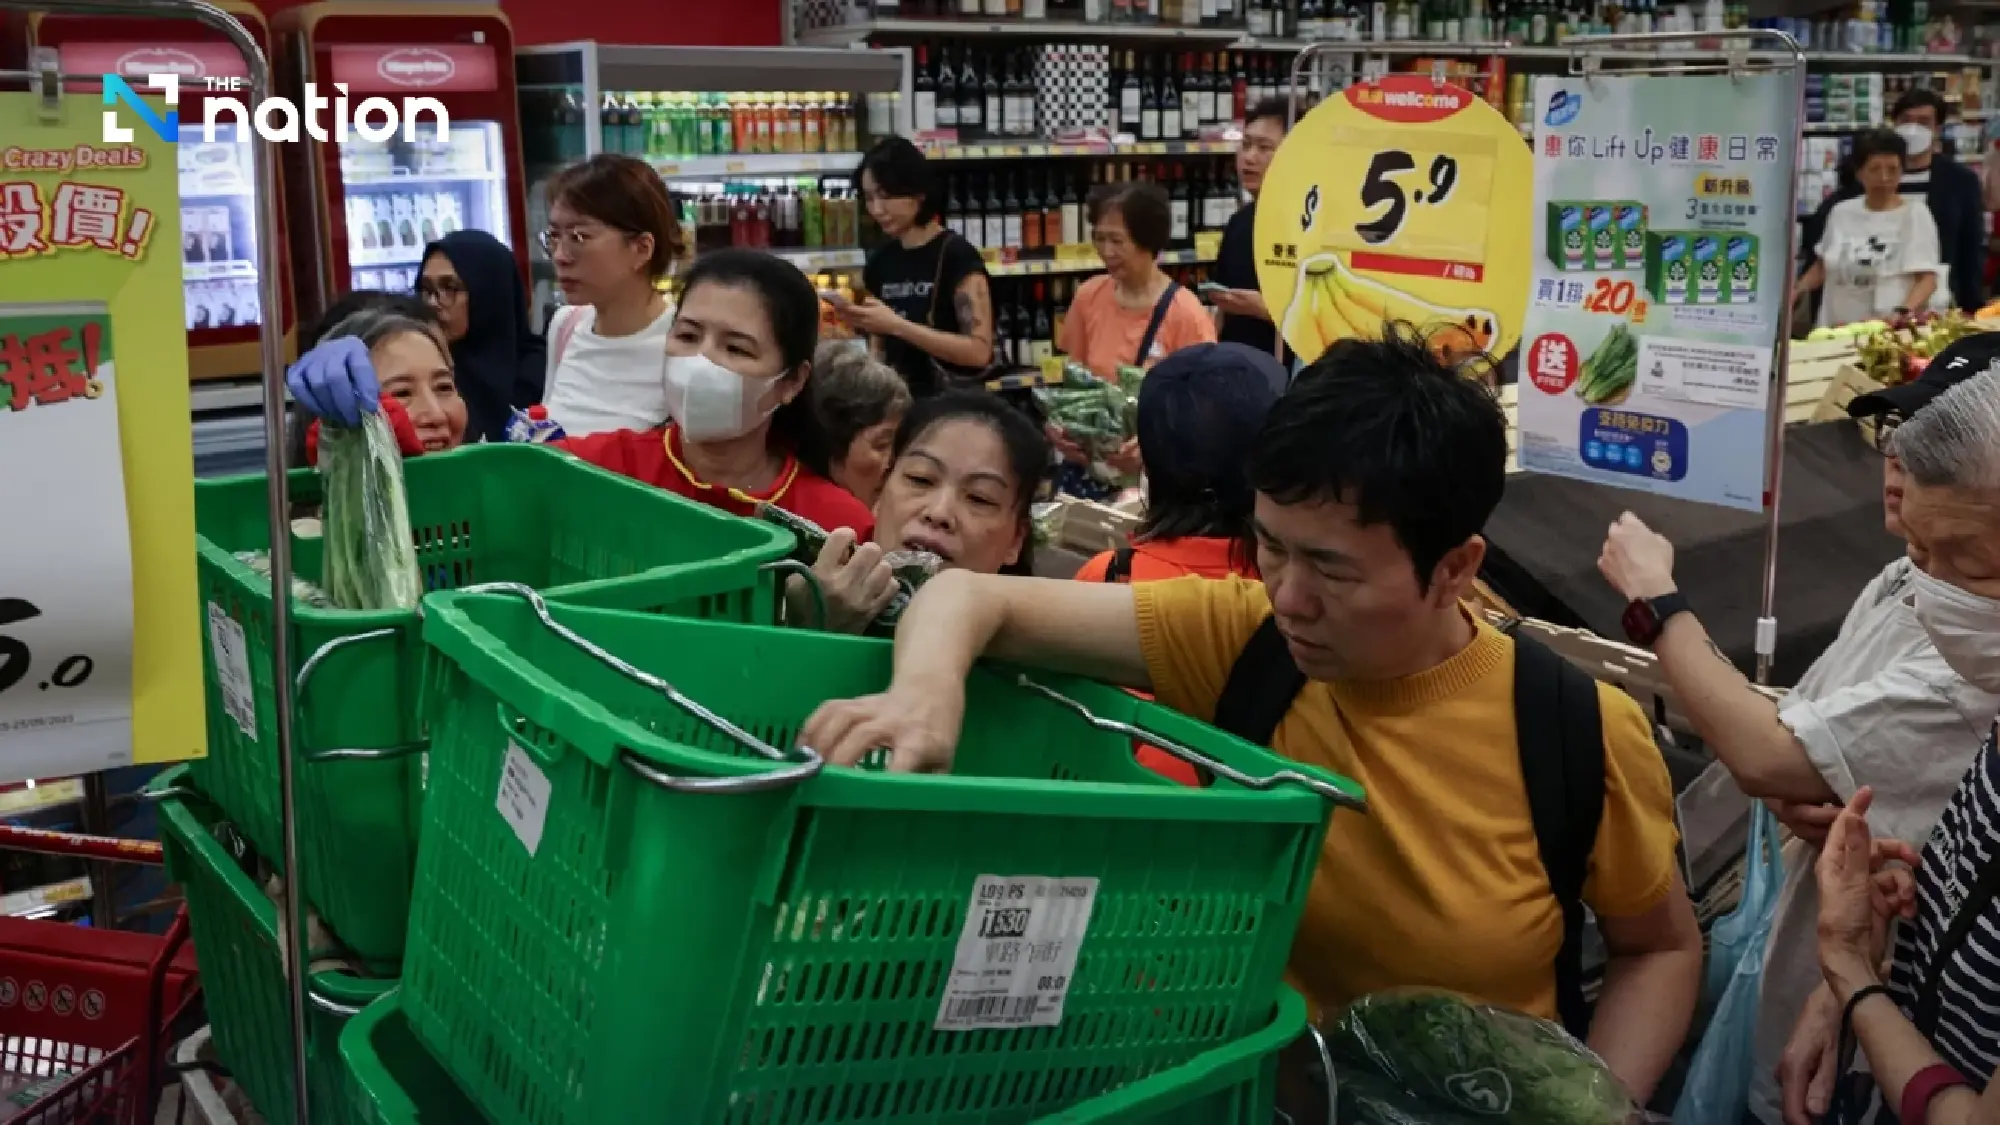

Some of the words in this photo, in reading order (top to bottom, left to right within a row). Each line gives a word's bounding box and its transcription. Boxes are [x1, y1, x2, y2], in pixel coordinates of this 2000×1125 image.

[4, 147, 73, 172] Crazy
[76, 144, 144, 167] Deals
[1592, 135, 1626, 158] Lift
[1634, 128, 1664, 164] Up
[1354, 150, 1458, 244] 5.9
